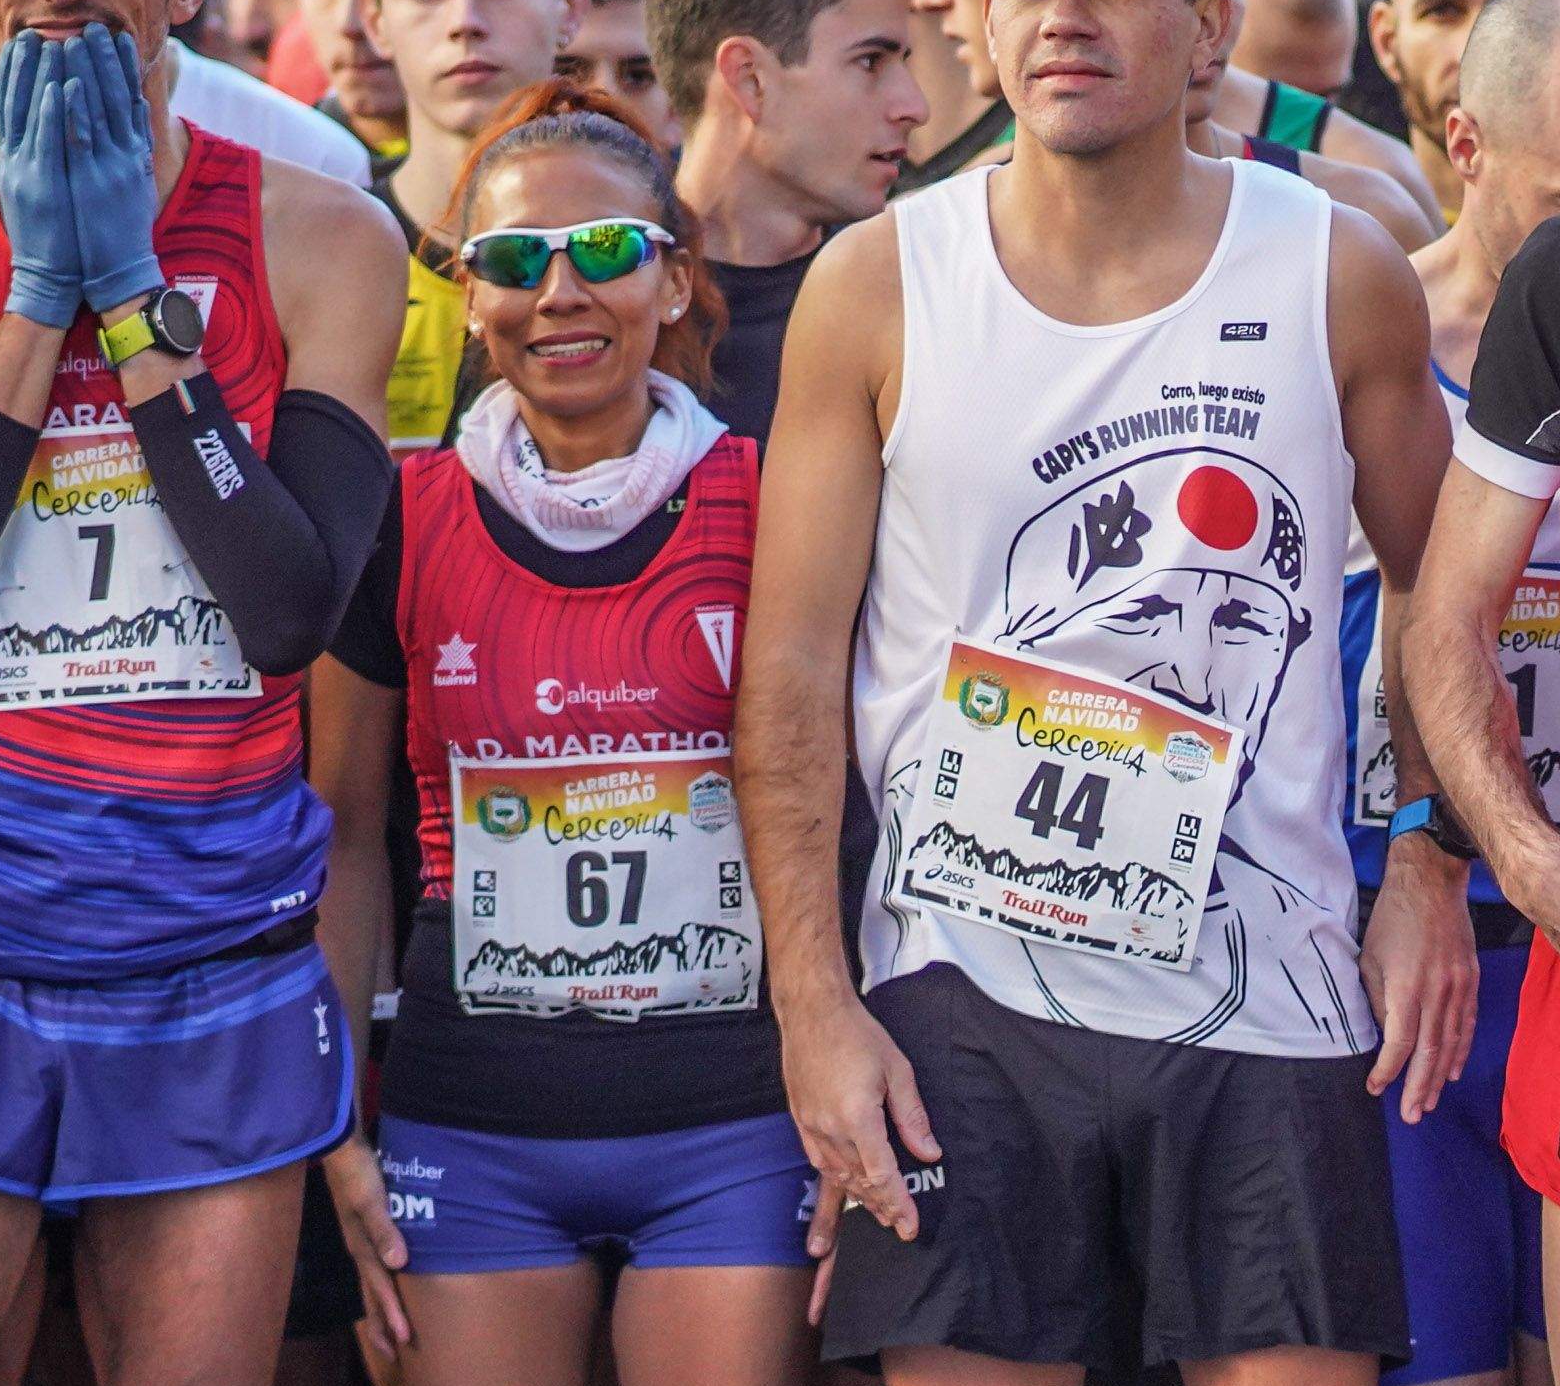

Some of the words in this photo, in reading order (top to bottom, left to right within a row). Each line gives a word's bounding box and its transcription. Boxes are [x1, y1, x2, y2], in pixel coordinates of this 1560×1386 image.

[1161, 383, 1196, 401] Corro,
[1198, 381, 1229, 401] luego
[1231, 387, 1266, 406] existo
[51, 440, 131, 472] CARRERA
[1032, 429, 1101, 485] CAPI'S
[1096, 403, 1199, 455] RUNNING
[1202, 402, 1261, 442] TEAM
[193, 427, 246, 501] 226ERS
[78, 523, 116, 602] 7
[63, 659, 113, 679] Trail
[114, 659, 157, 678] Run
[566, 679, 660, 712] alquiber
[1046, 688, 1129, 713] CARRERA
[1041, 704, 1141, 733] NAVIDAD
[565, 769, 643, 795] CARRERA
[565, 782, 657, 816] NAVIDAD
[1014, 760, 1111, 852] 44
[565, 850, 648, 928] 67
[942, 870, 976, 890] asics
[1001, 889, 1047, 916] Trail
[1047, 906, 1089, 928] Run
[501, 984, 535, 997] asics
[567, 983, 618, 1001] Trail
[618, 984, 659, 1000] Run
